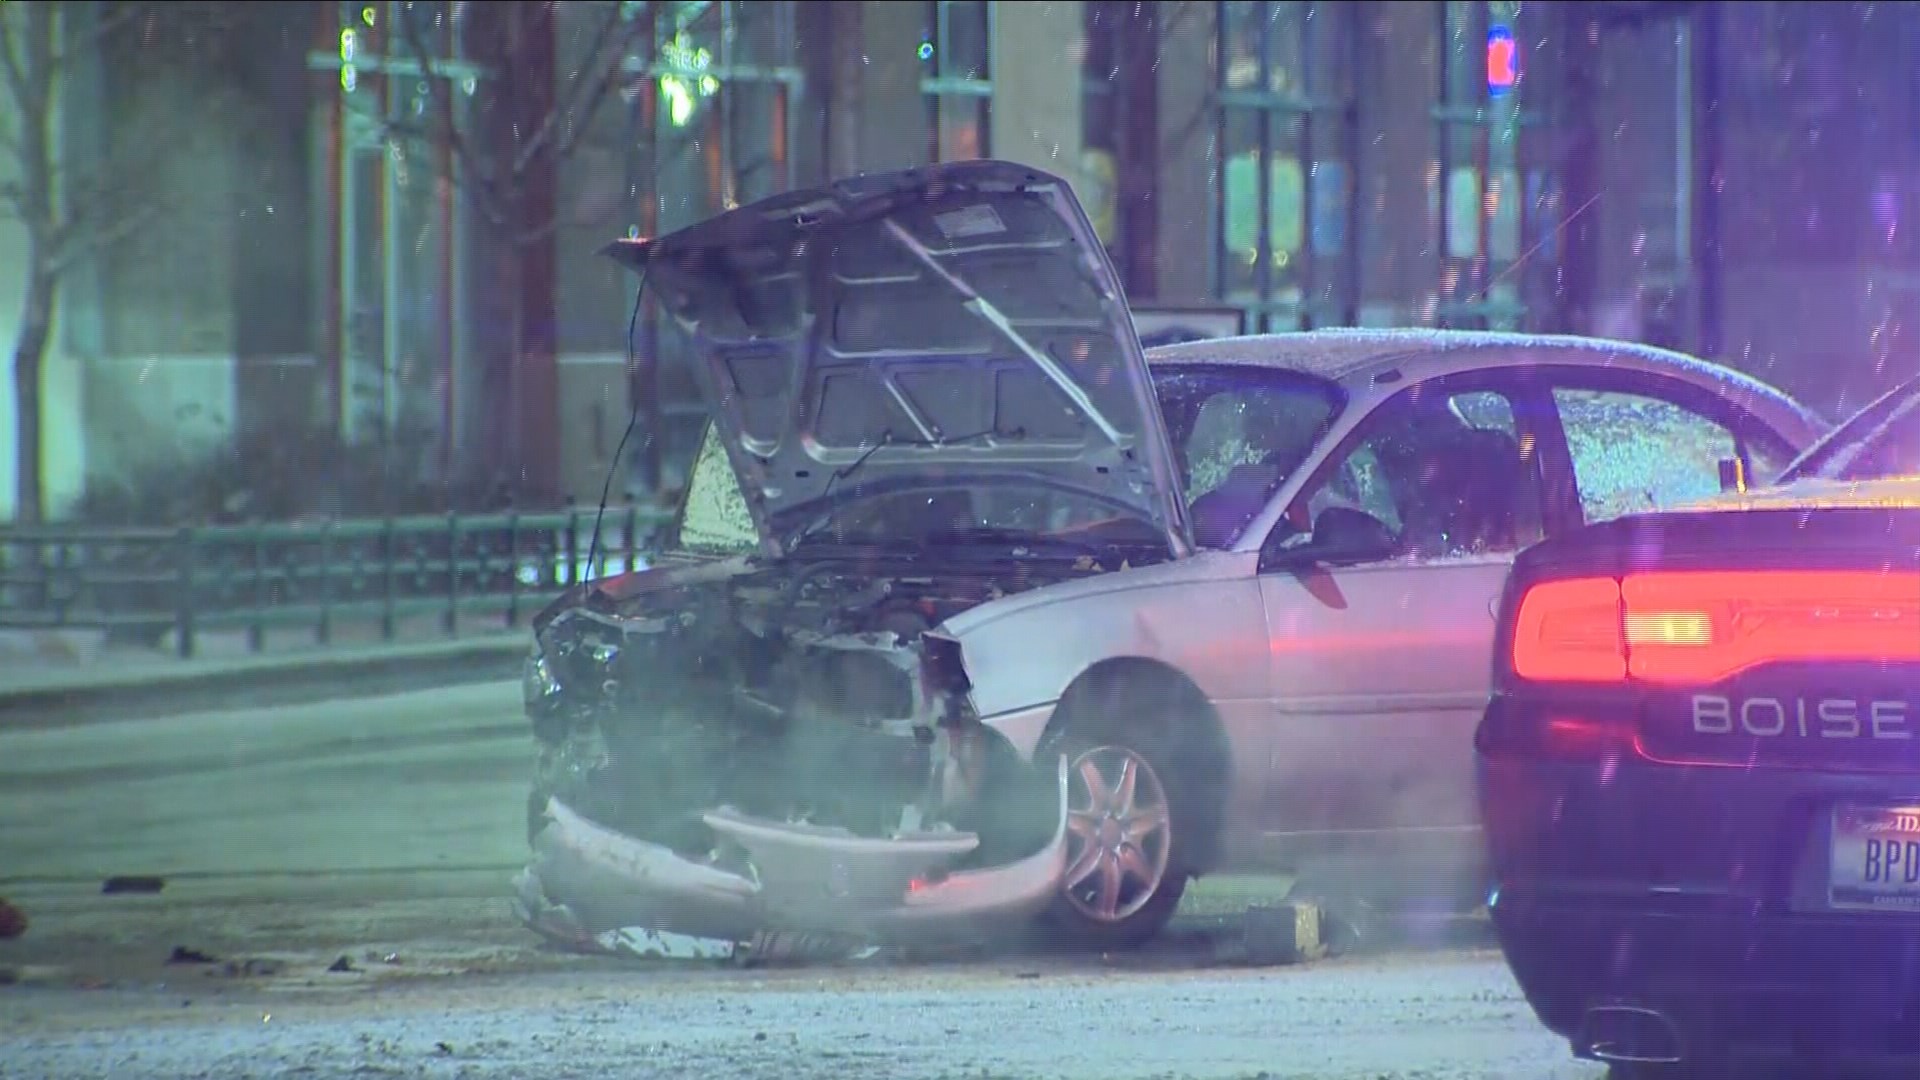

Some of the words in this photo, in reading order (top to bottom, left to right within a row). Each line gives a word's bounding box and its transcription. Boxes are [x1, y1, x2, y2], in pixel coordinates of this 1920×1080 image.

[1692, 694, 1913, 739] BOISE
[1896, 815, 1920, 832] ID
[1865, 839, 1919, 883] BPD
